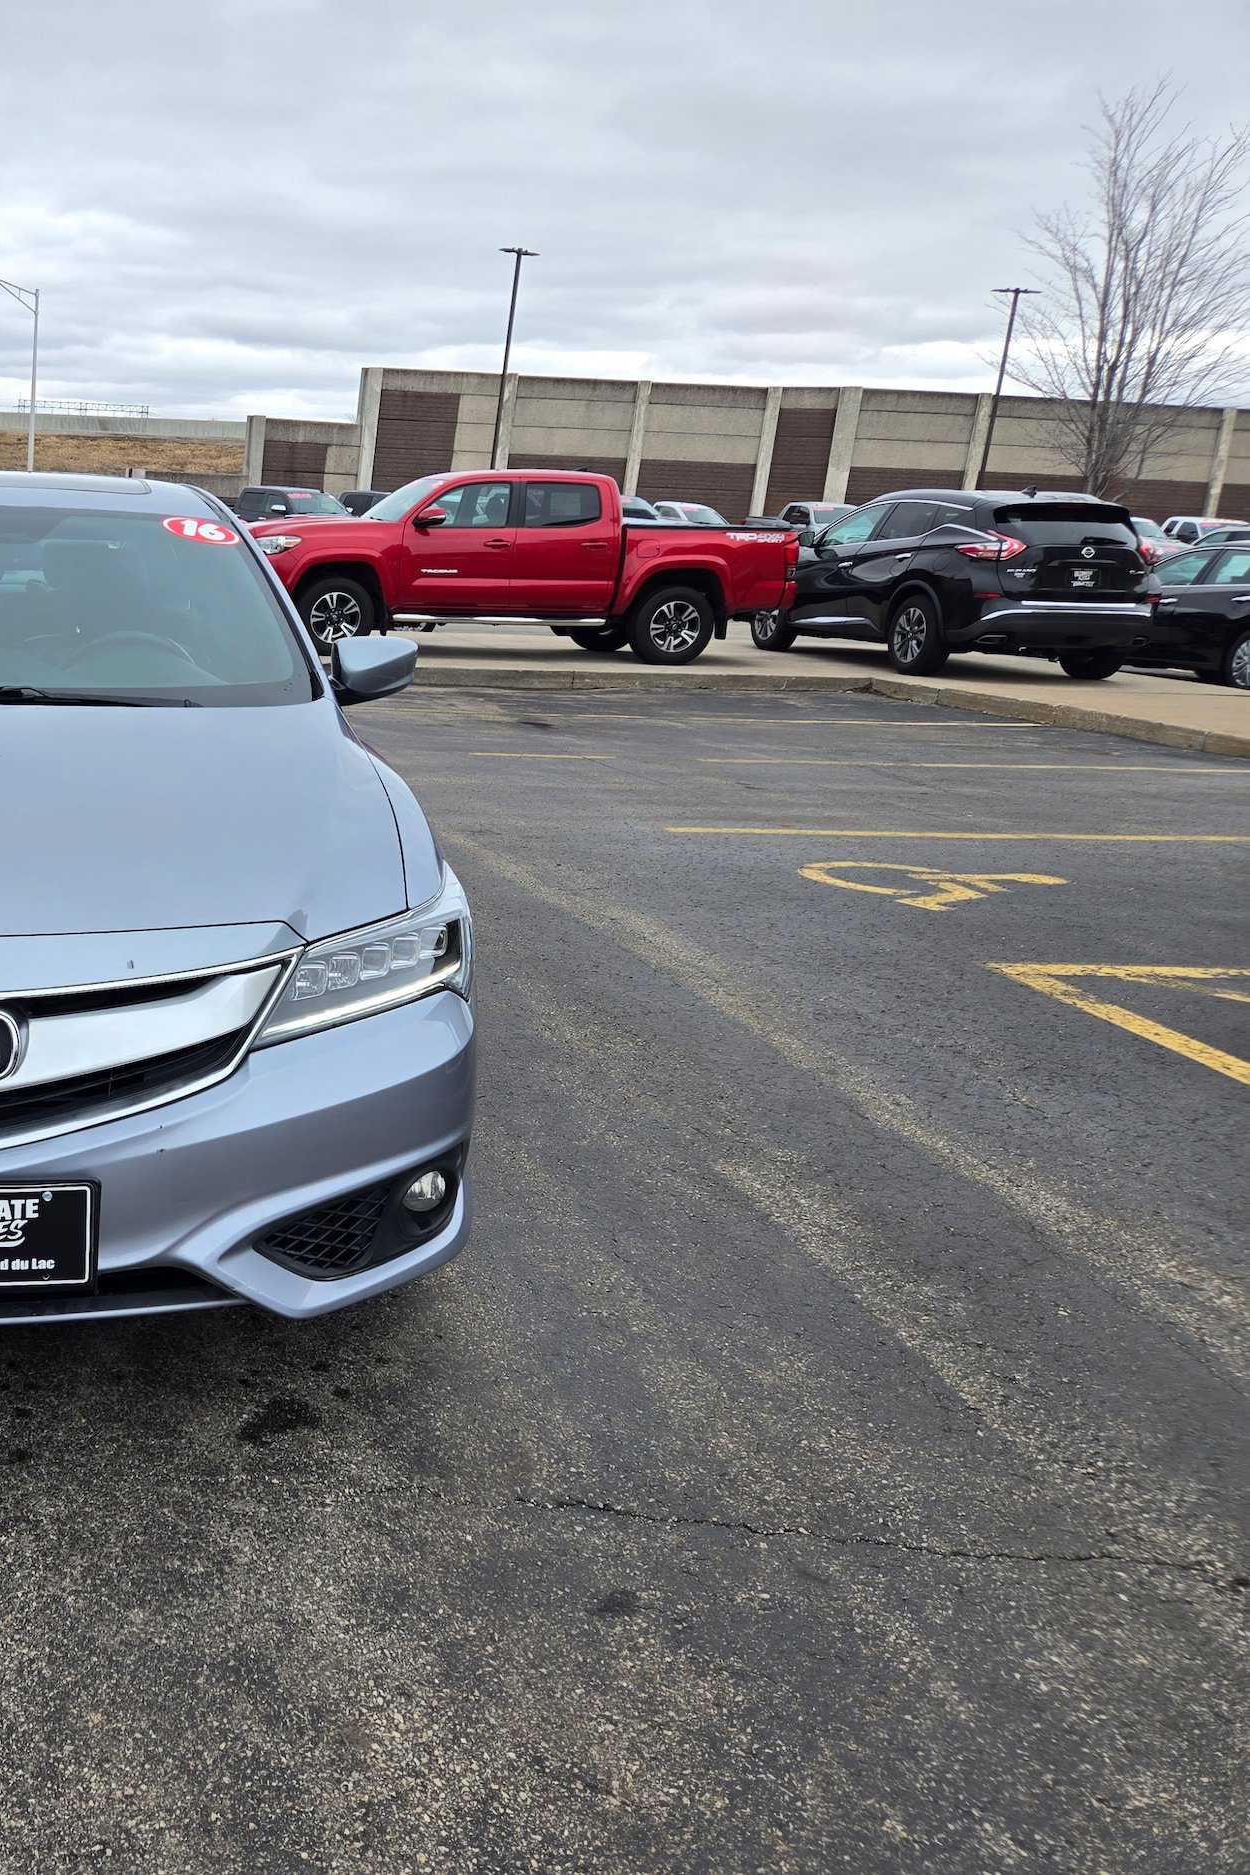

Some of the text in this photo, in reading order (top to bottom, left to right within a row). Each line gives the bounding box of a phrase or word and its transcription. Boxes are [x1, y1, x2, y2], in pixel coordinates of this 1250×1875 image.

[181, 519, 225, 540] 16
[726, 532, 757, 542] TRD
[11, 1257, 29, 1271] du
[31, 1257, 56, 1270] Lac
